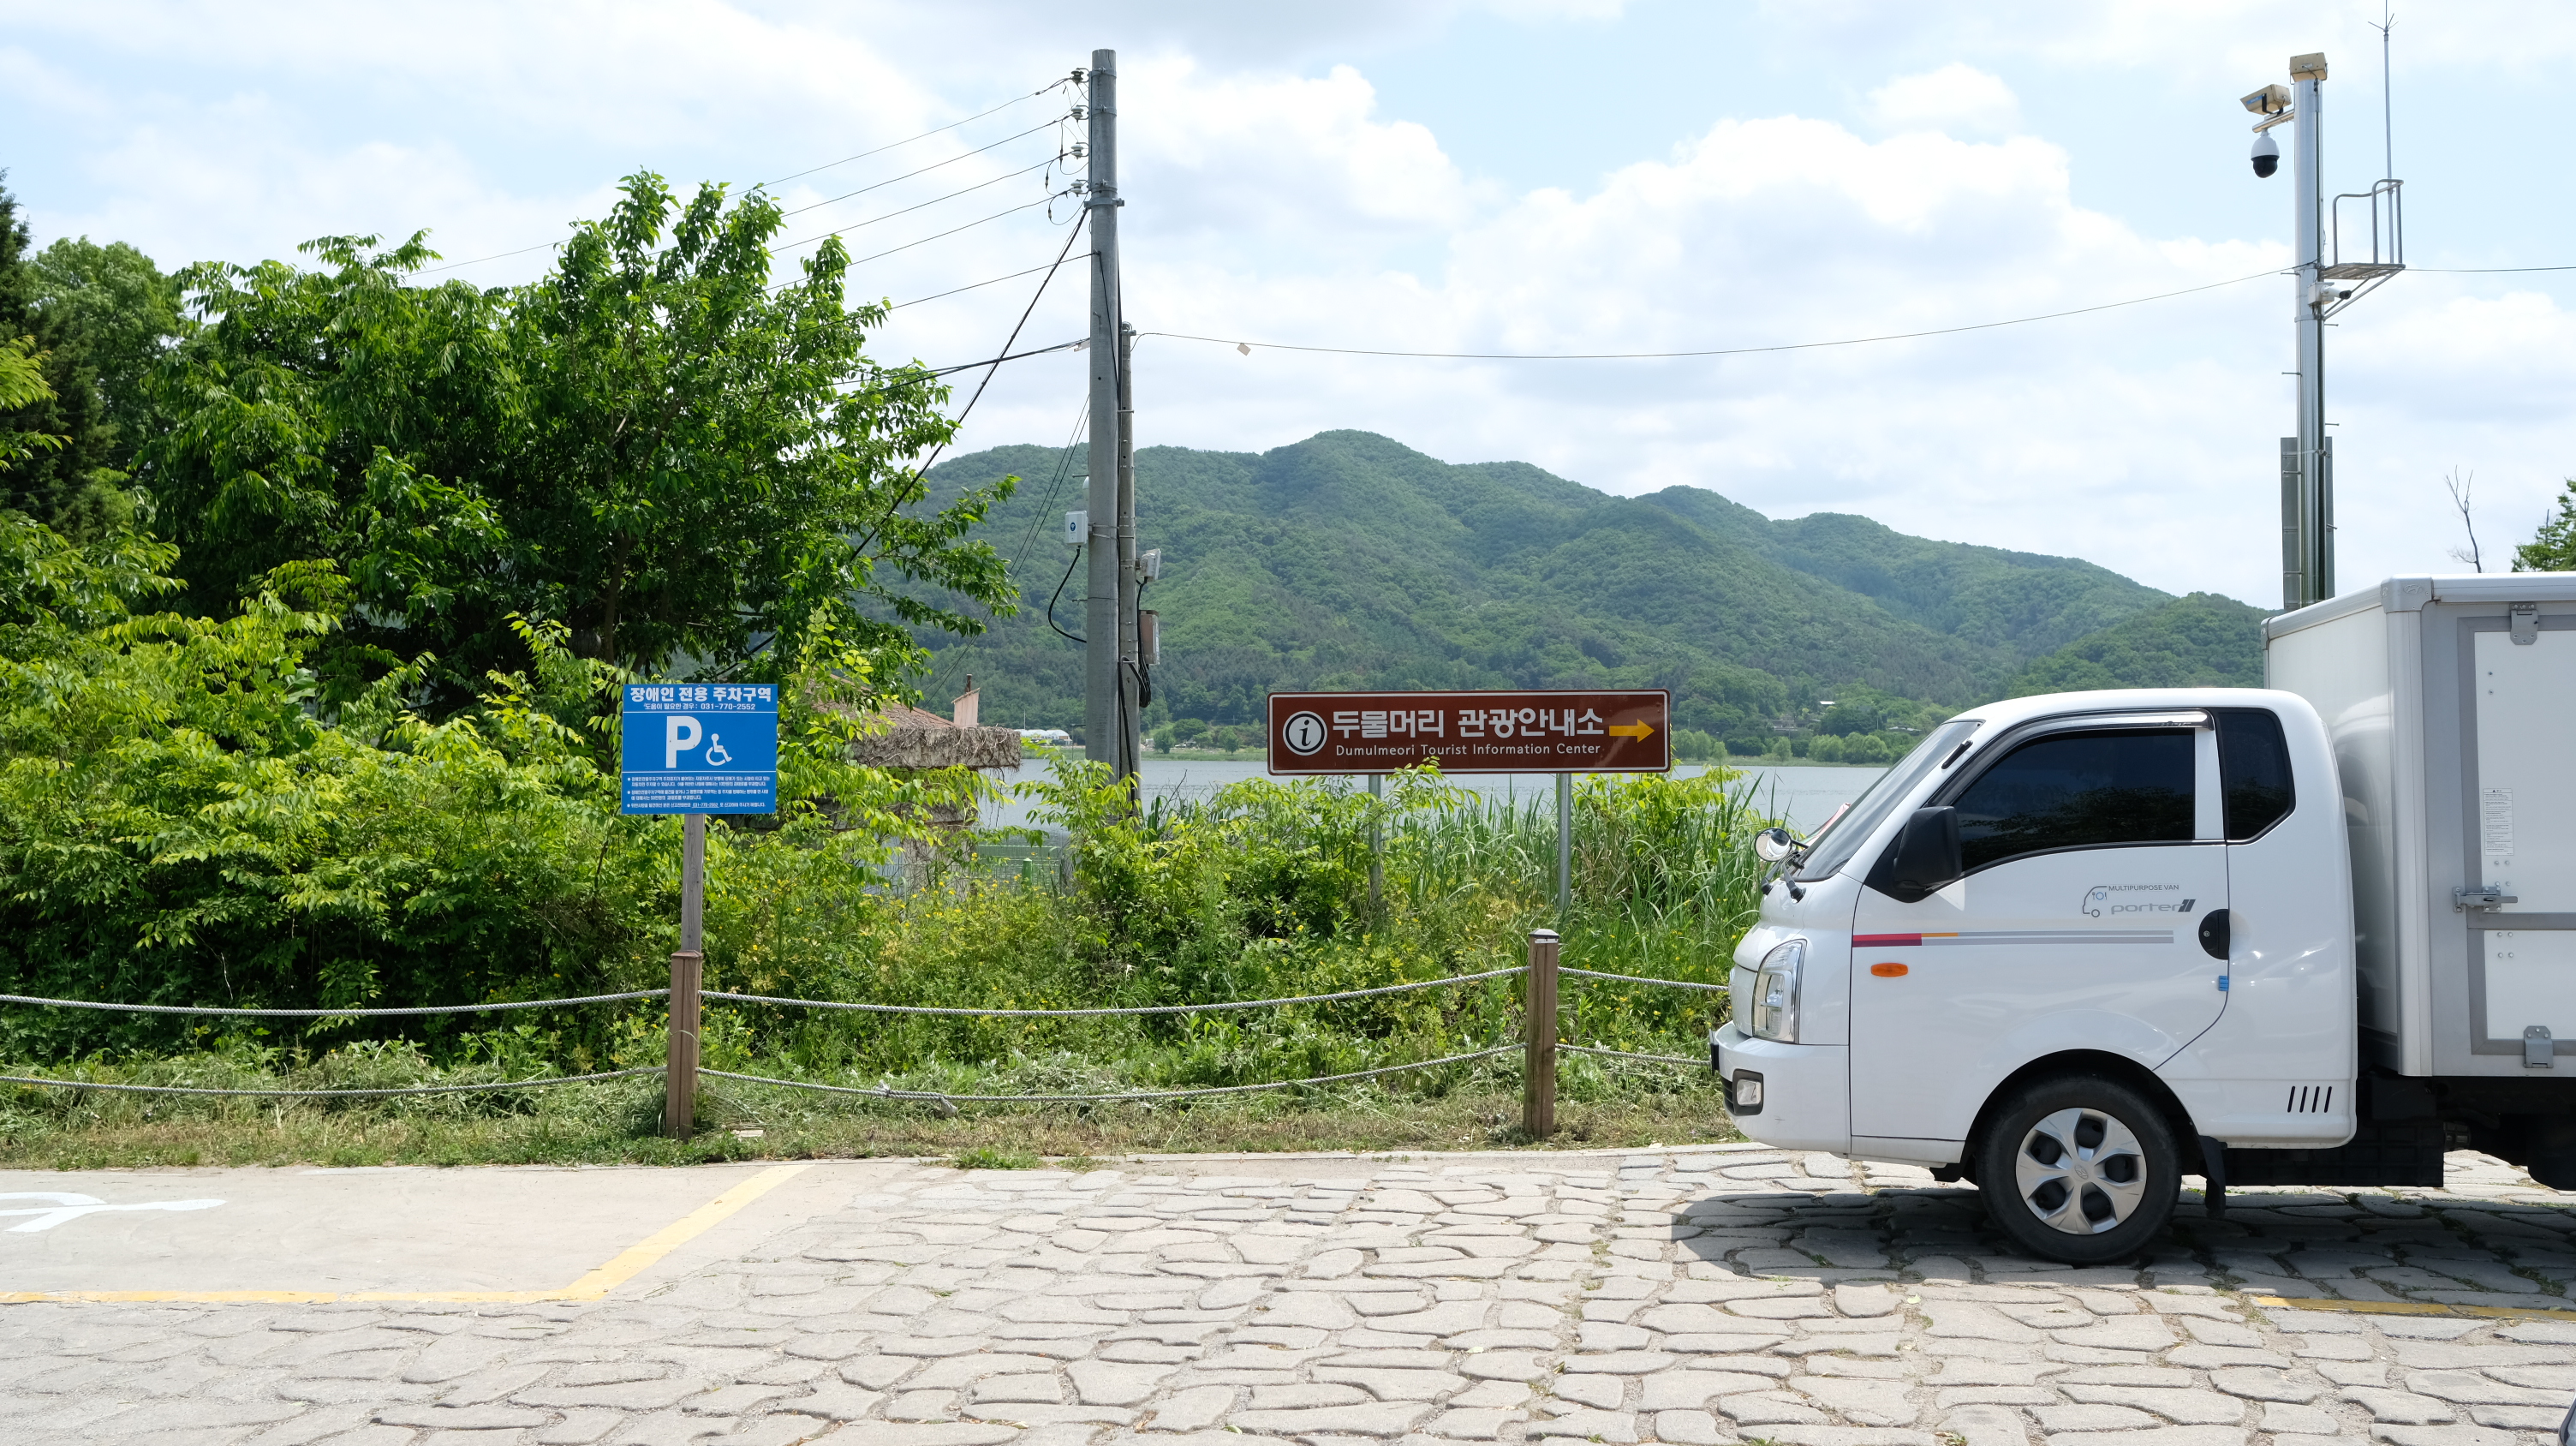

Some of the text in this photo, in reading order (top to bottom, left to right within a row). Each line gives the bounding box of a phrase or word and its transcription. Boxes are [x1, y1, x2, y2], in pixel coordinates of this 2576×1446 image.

[629, 687, 771, 702] 장애인 전용 주차구역
[1333, 708, 1604, 739] 두물머리 관광안내소
[665, 715, 702, 768] P
[1336, 743, 1601, 756] Dumulmeori Tourist Information Center
